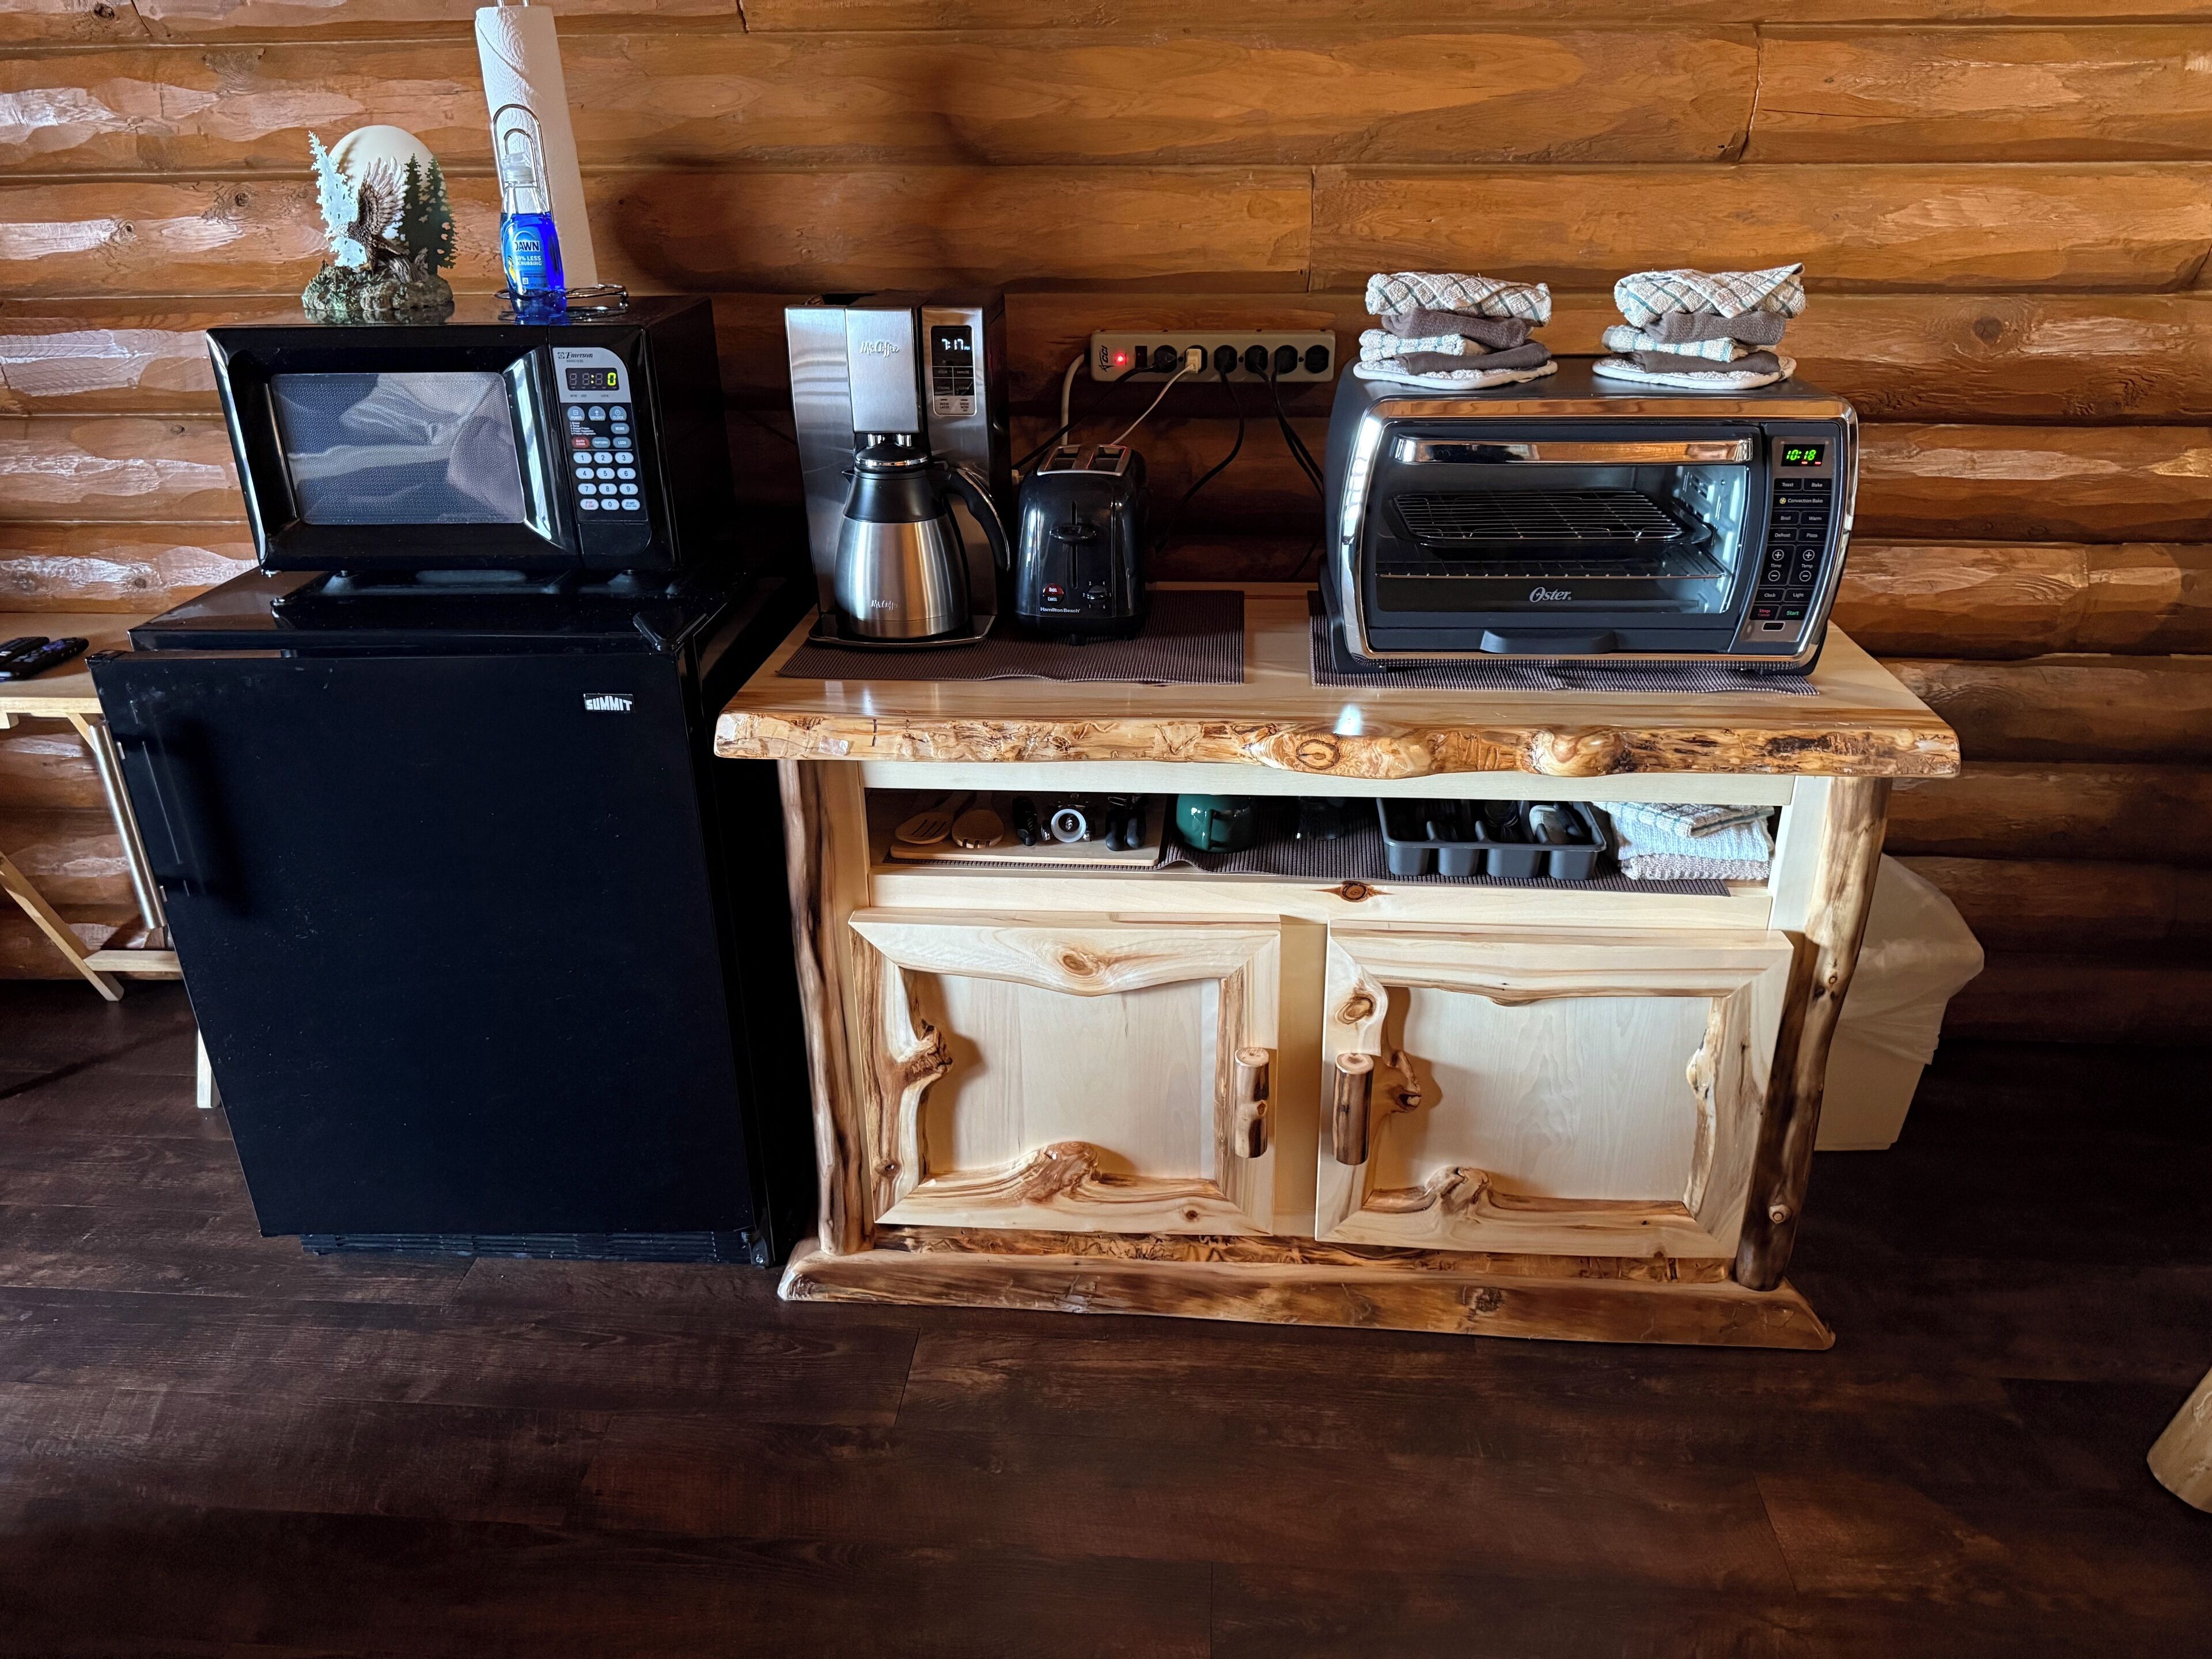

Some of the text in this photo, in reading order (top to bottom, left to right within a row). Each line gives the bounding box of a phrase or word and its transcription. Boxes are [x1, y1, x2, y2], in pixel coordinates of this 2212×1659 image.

[876, 341, 900, 358] Coffee
[941, 338, 964, 350] 7:17
[1786, 449, 1817, 461] 10:18
[1529, 586, 1571, 603] Oster
[586, 695, 632, 711] SUMMIT
